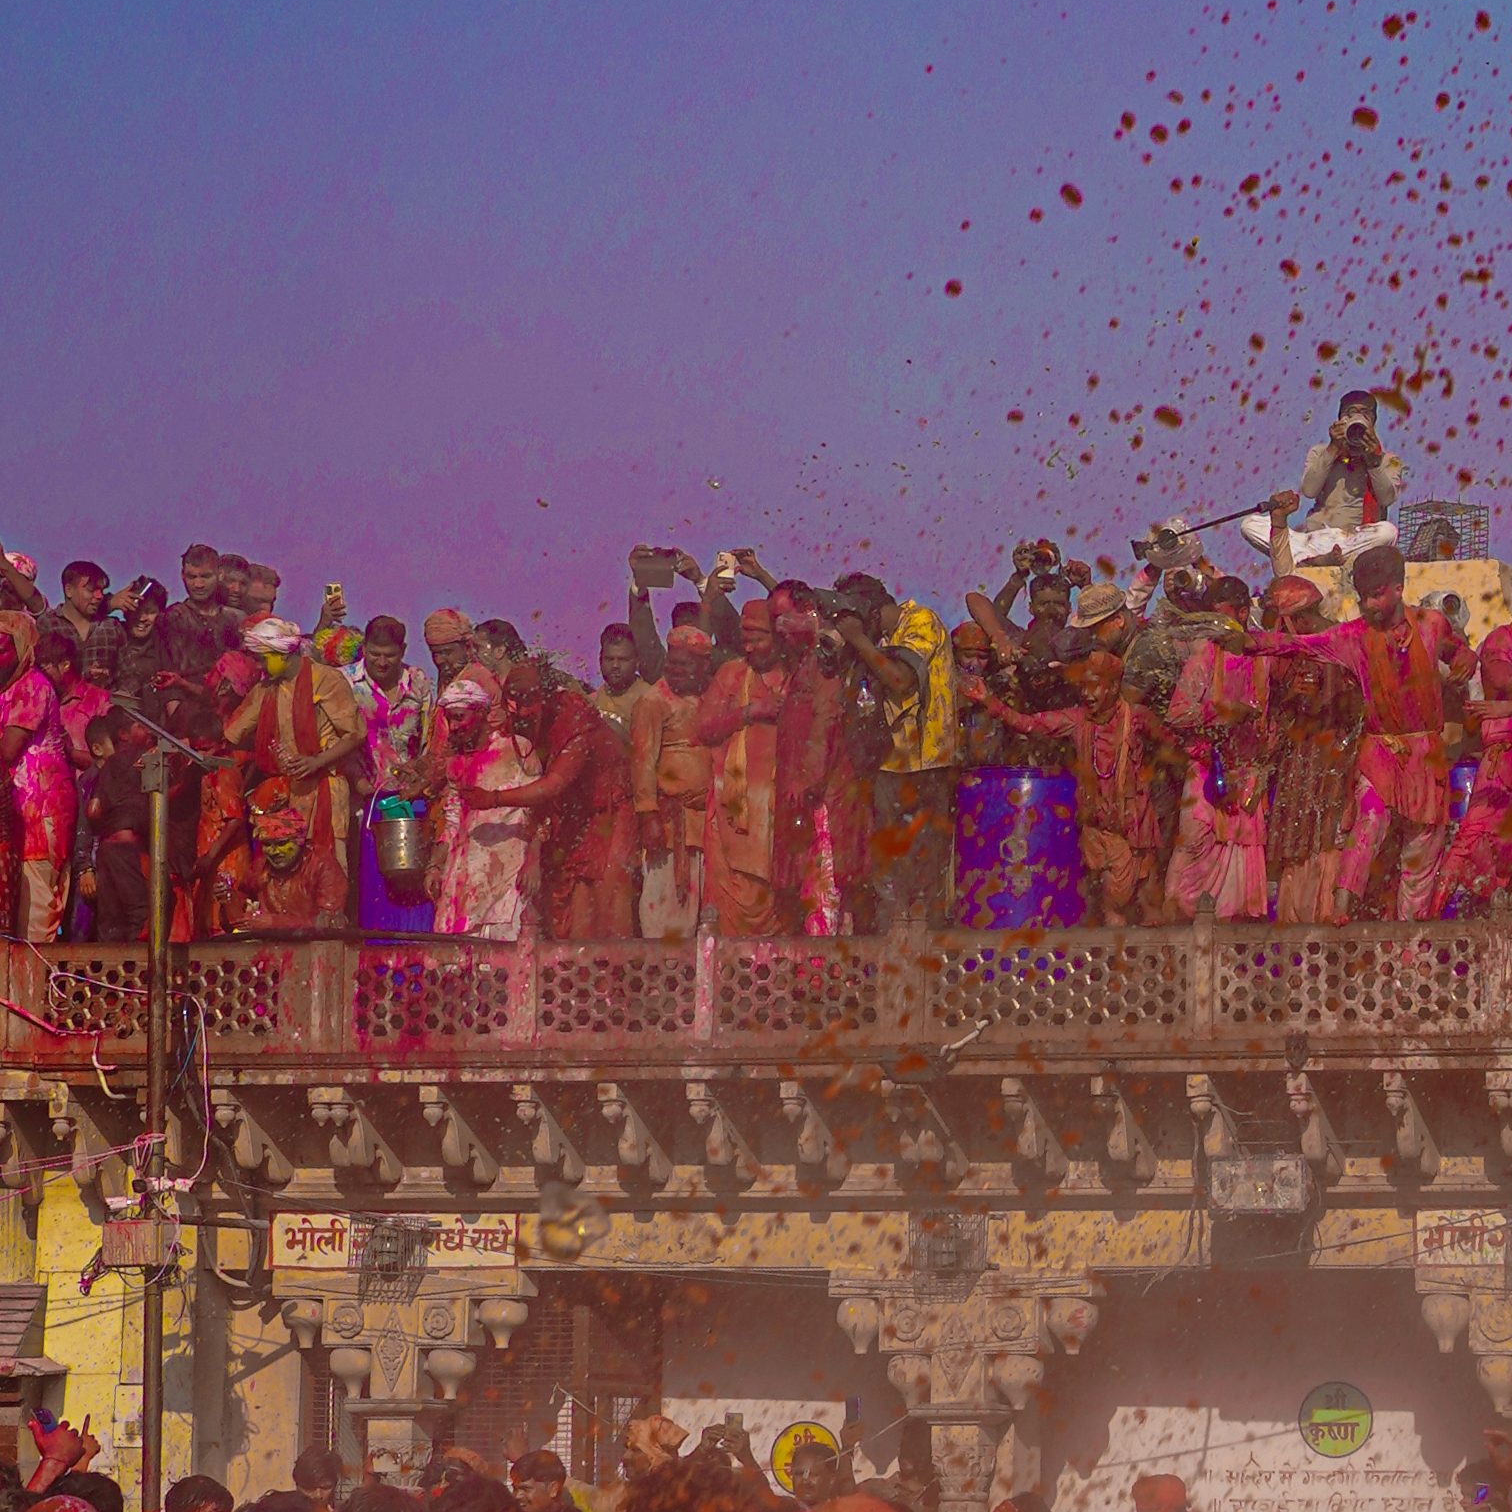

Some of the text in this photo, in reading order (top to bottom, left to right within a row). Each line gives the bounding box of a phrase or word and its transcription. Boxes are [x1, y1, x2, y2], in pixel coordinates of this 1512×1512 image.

[285, 1218, 348, 1256] भोली
[471, 1219, 512, 1256] राधे
[1422, 1212, 1488, 1258] भोली
[1309, 1421, 1360, 1446] कृष्ण
